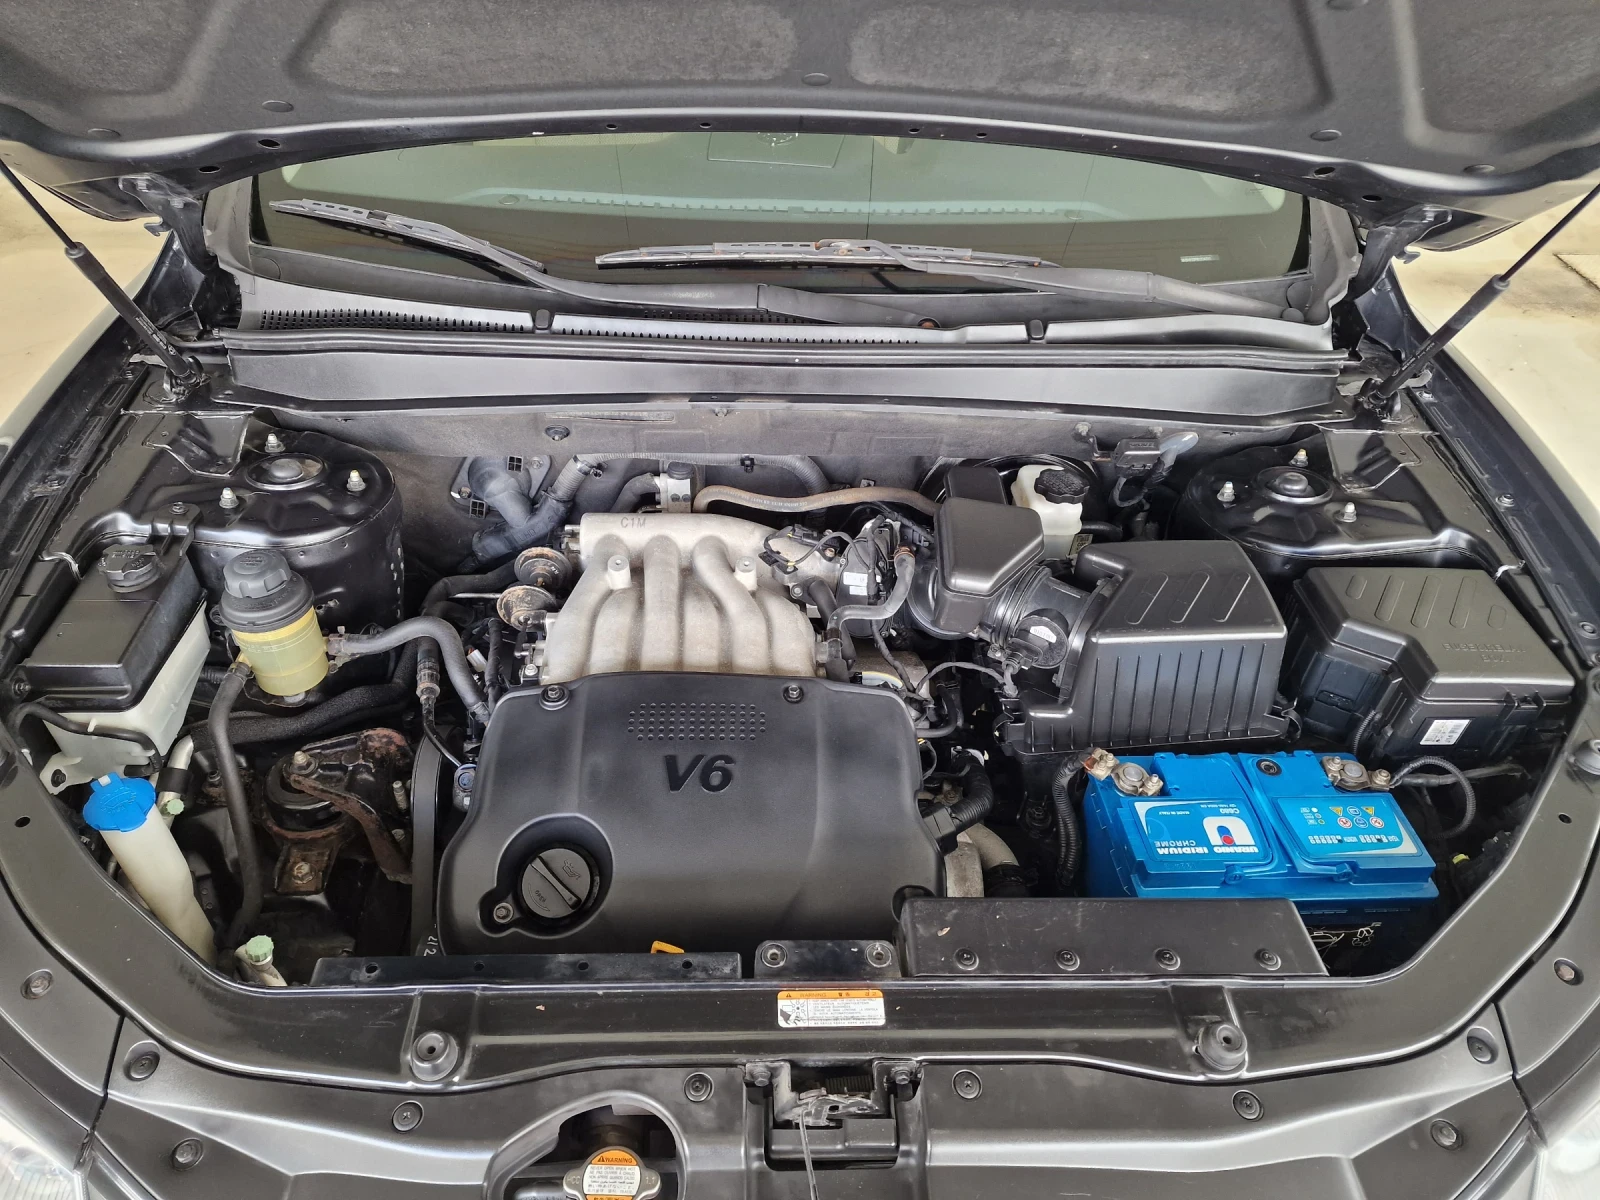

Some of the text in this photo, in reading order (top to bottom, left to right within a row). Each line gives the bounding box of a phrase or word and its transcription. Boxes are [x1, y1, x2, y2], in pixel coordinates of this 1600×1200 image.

[620, 516, 646, 528] C1M
[664, 754, 736, 793] V6
[1156, 846, 1259, 855] URANIO IRIDIUM
